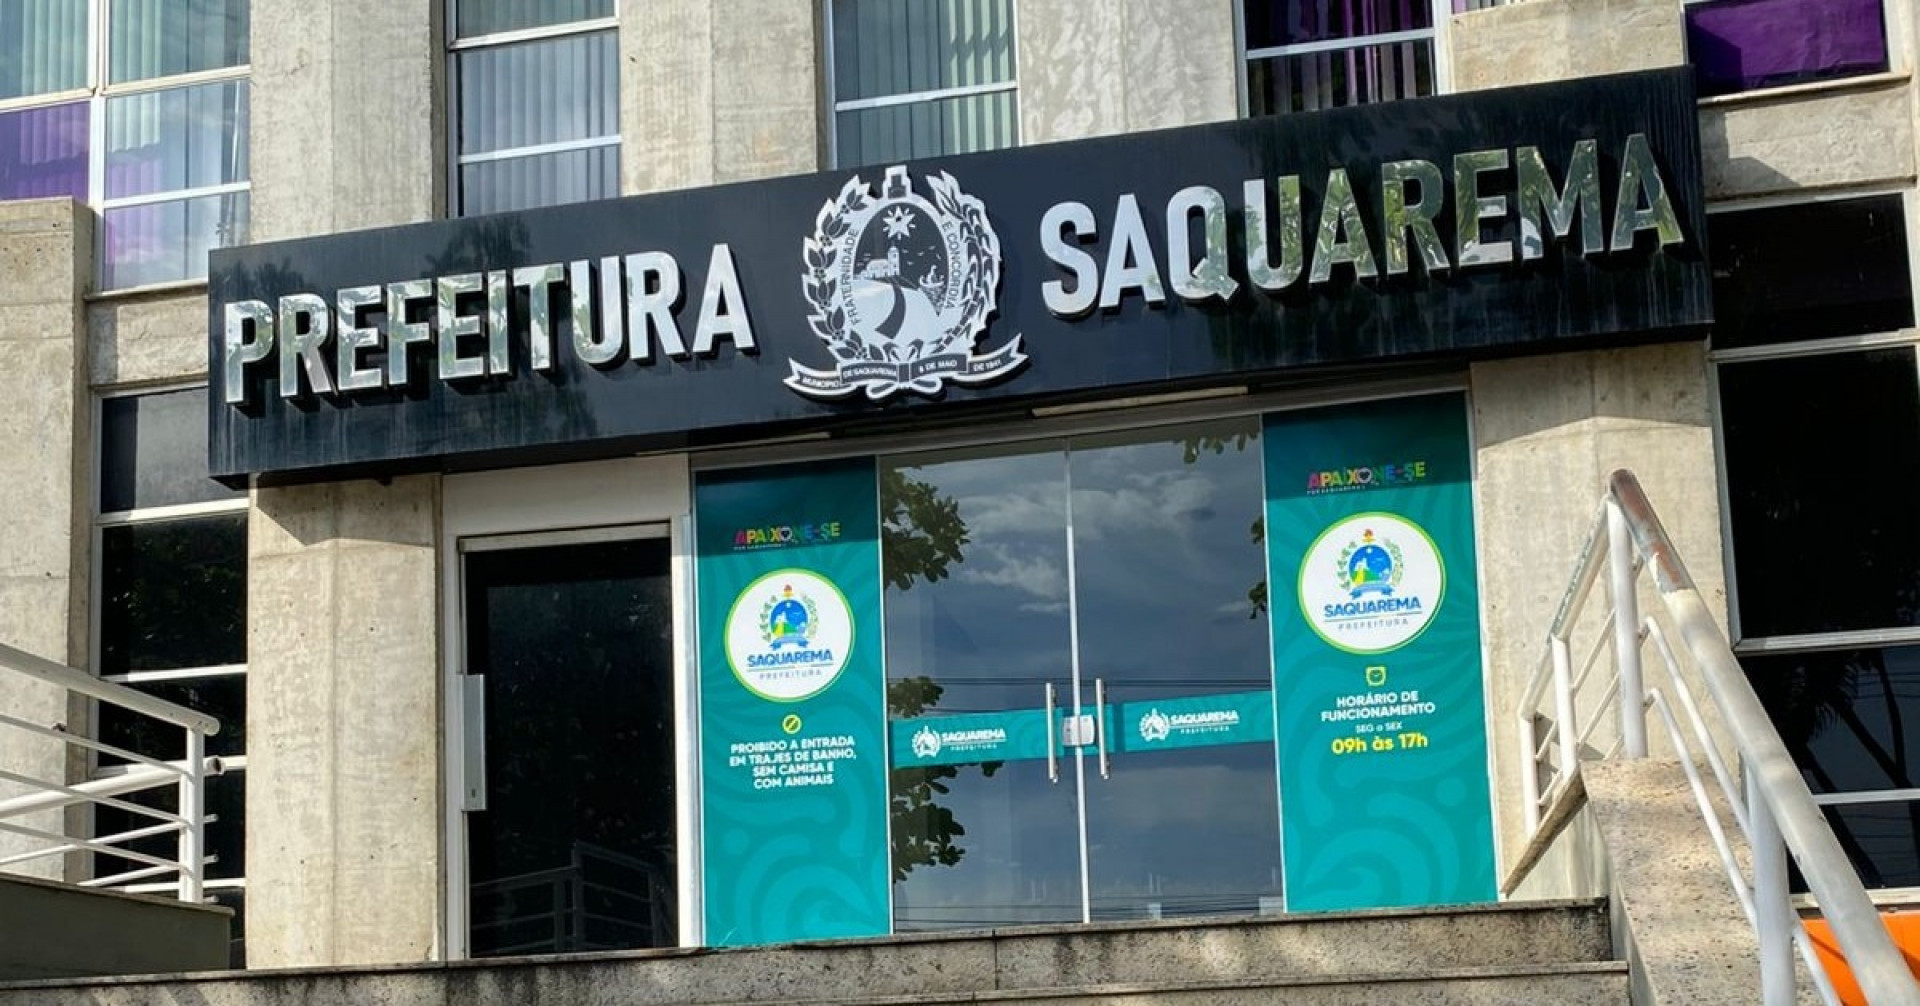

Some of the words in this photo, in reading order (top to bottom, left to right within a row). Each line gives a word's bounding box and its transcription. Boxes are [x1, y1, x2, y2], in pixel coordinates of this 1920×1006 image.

[223, 243, 756, 404] PREFEITURA
[1040, 133, 1685, 317] SAQUAREMA
[840, 228, 861, 325] FRATERNIDADE
[942, 221, 953, 232] E
[1324, 596, 1422, 618] SAQUAREMA
[1338, 618, 1409, 630] PREFEITURA
[747, 649, 834, 667] SAQUAREMA
[759, 669, 822, 680] PREFEITURA
[1336, 691, 1397, 708] HORÁRIO
[1401, 690, 1419, 702] DE
[1170, 710, 1240, 725] SAQUAREMA
[1321, 702, 1435, 722] FUNCIONAMENTO
[941, 728, 1006, 743] SAQUAREMA
[1355, 723, 1374, 733] SEG
[1385, 721, 1403, 732] SEX
[730, 740, 787, 754] PROIBIDO
[789, 739, 799, 750] A
[801, 735, 856, 749] ENTRADA
[1331, 737, 1367, 755] 09h
[1372, 735, 1394, 751] às
[1398, 731, 1428, 749] 17h
[729, 755, 746, 767] EM
[748, 752, 791, 765] TRAJES
[794, 751, 810, 762] DE
[812, 748, 857, 760] BANHO,
[752, 766, 777, 777] SEM
[778, 763, 825, 776] CAMISA
[826, 761, 835, 772] E
[753, 777, 782, 789] COM
[784, 774, 834, 787] ANIMAIS
